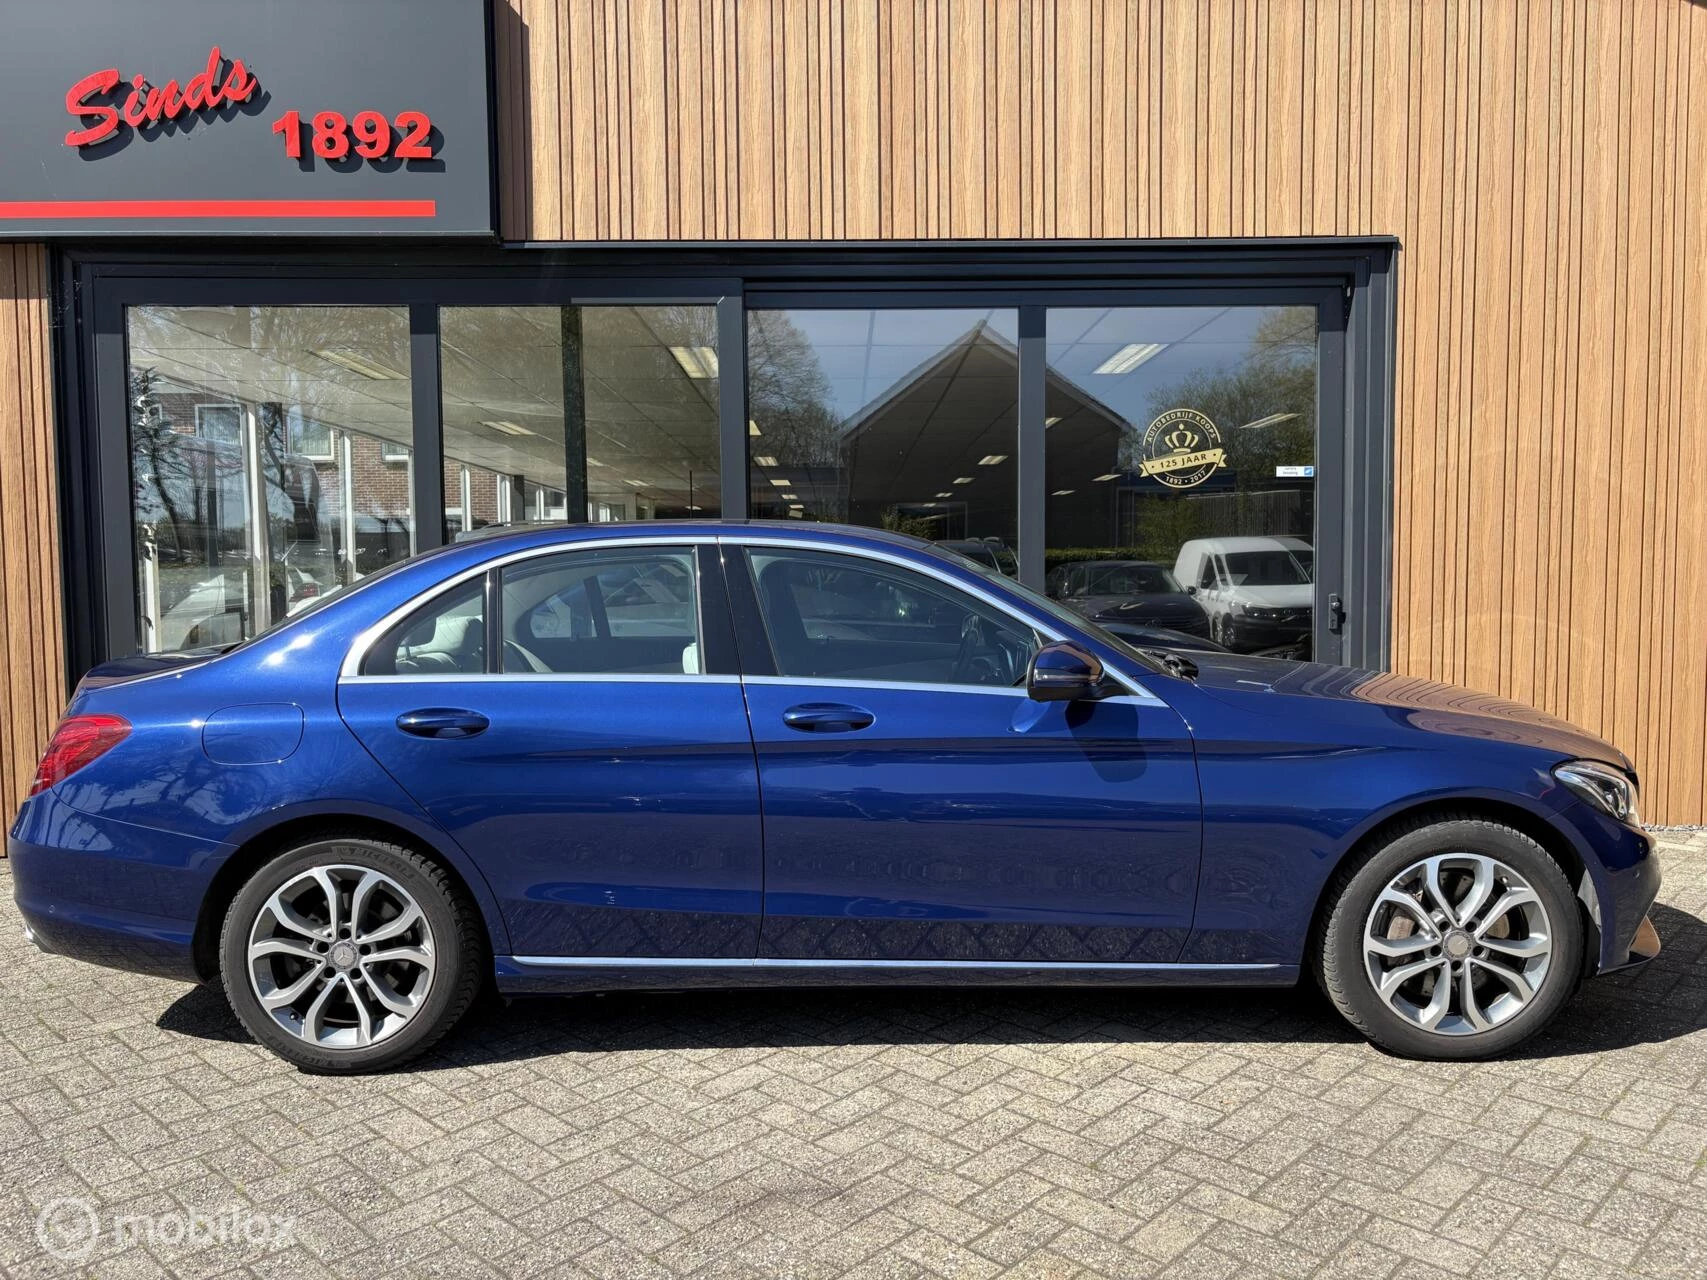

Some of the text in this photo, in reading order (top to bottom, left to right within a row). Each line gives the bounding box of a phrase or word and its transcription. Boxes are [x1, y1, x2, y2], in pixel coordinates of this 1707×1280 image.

[65, 46, 257, 147] Sinds
[272, 110, 432, 158] 1892
[1147, 412, 1216, 442] AUTOBEDRIJF KOOPS
[1160, 453, 1207, 468] 125 JAAR
[1166, 470, 1206, 485] 1892 2017
